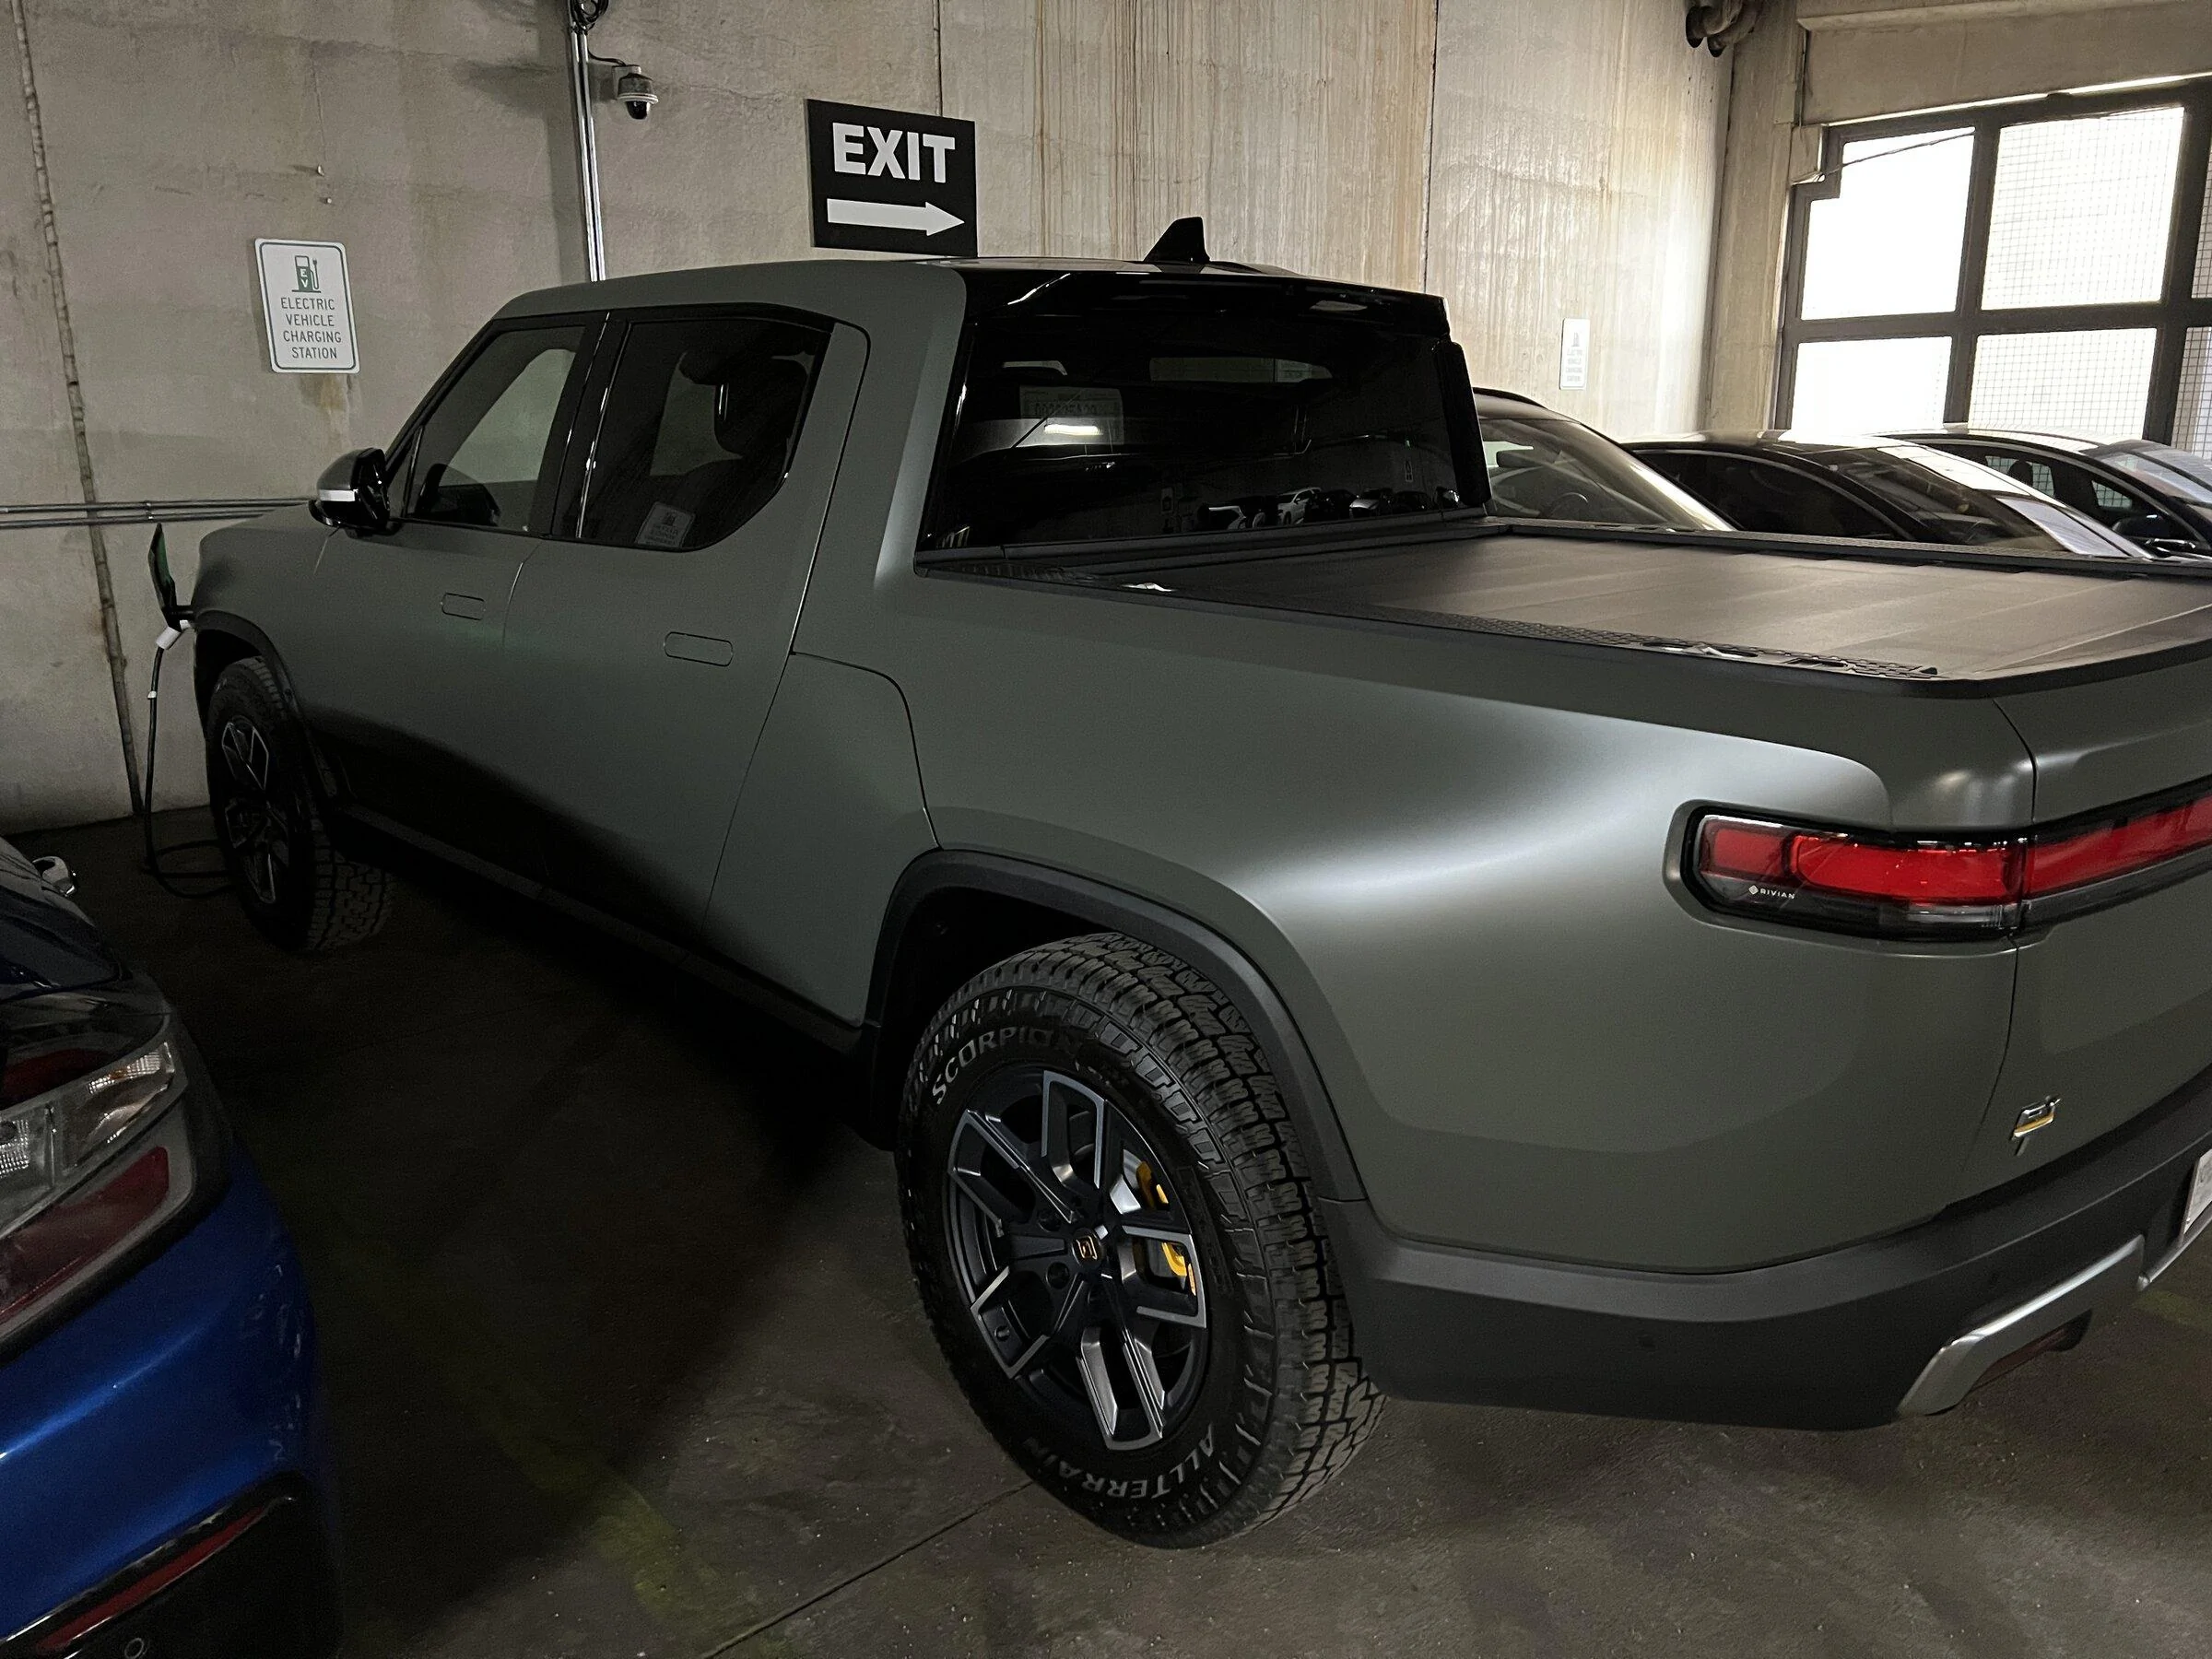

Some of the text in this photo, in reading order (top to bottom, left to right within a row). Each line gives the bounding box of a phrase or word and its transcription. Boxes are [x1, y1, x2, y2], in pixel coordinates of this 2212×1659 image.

[832, 122, 956, 183] EXIT
[280, 297, 335, 311] ELECTRIC
[286, 313, 335, 327] VEHICLE
[283, 330, 342, 344] CHARGING
[291, 347, 337, 359] STATION
[1759, 888, 1795, 900] RIVIAN
[932, 1025, 1067, 1105] SCORPIO
[1169, 1424, 1215, 1484] ALL
